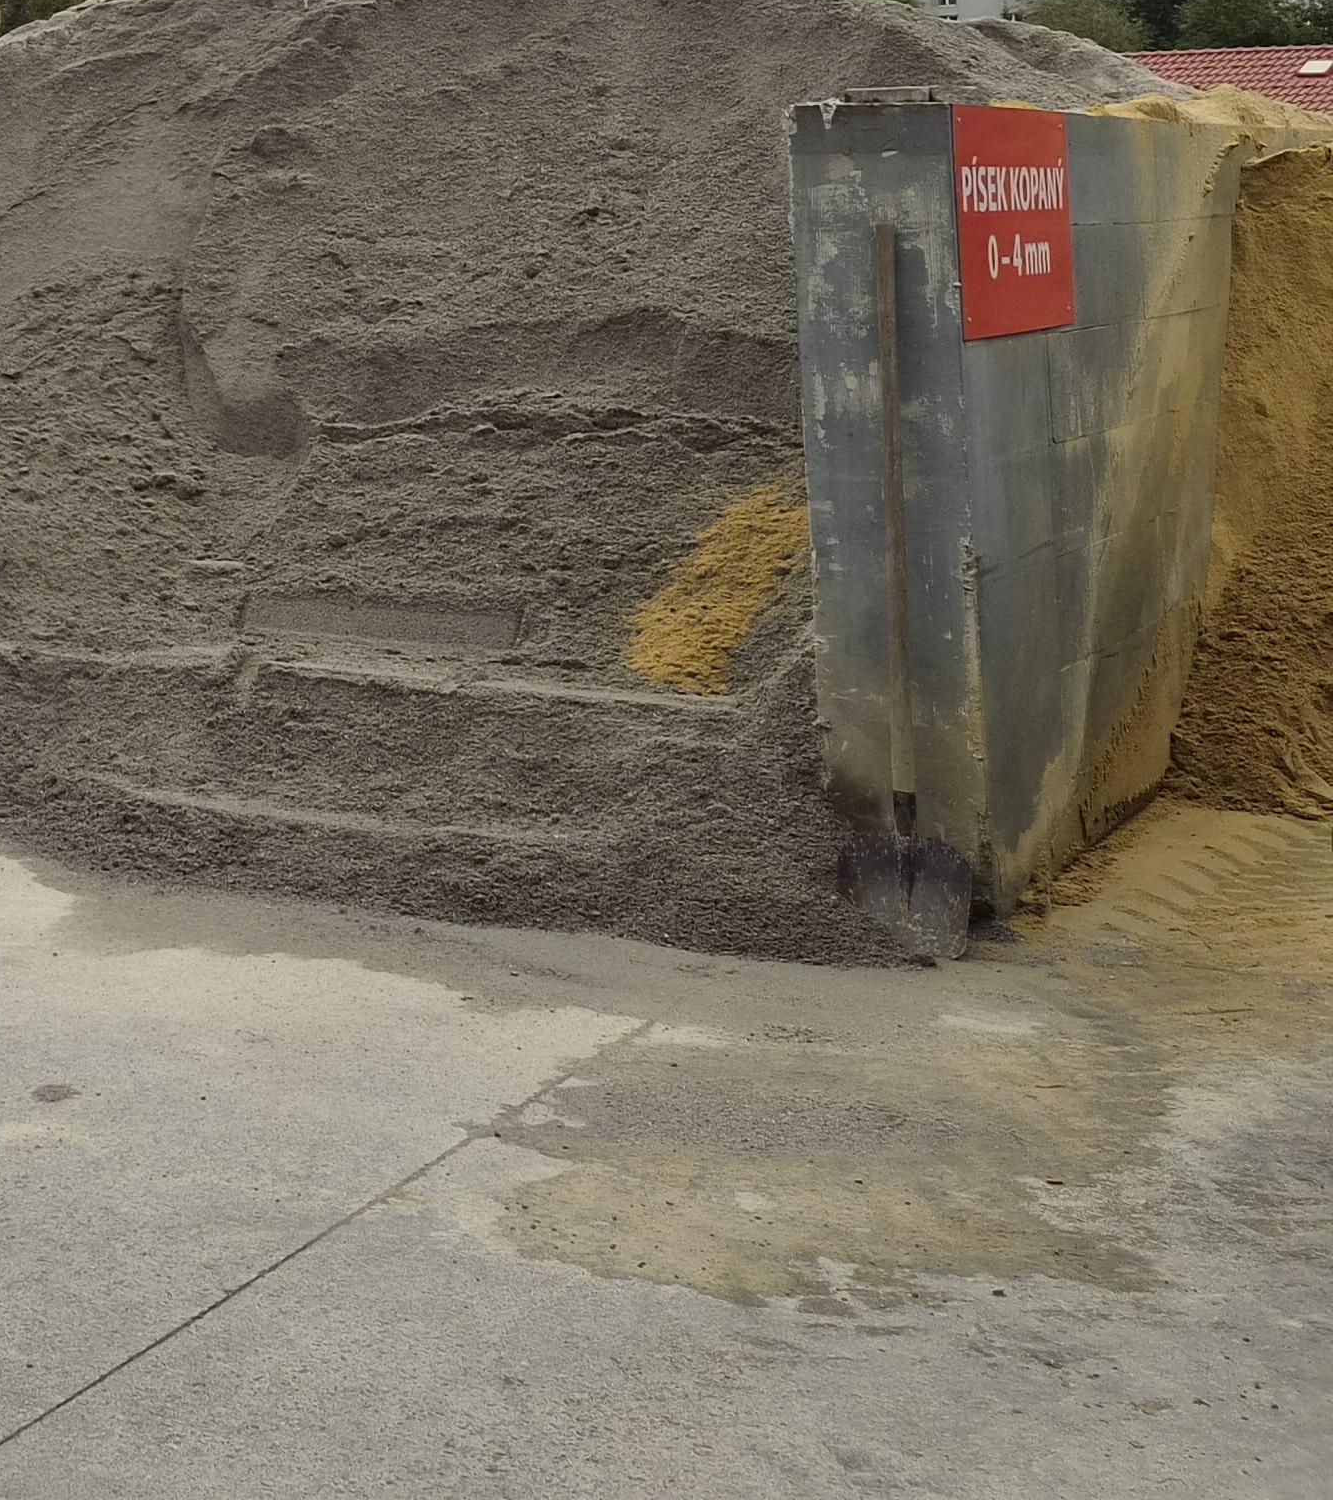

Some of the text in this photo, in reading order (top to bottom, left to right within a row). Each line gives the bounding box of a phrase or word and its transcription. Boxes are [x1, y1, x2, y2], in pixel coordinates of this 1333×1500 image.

[961, 156, 1064, 213] PÍSEK KOPANÝ
[988, 235, 999, 279] 0
[1012, 233, 1023, 276] 4
[1024, 242, 1051, 275] mm
